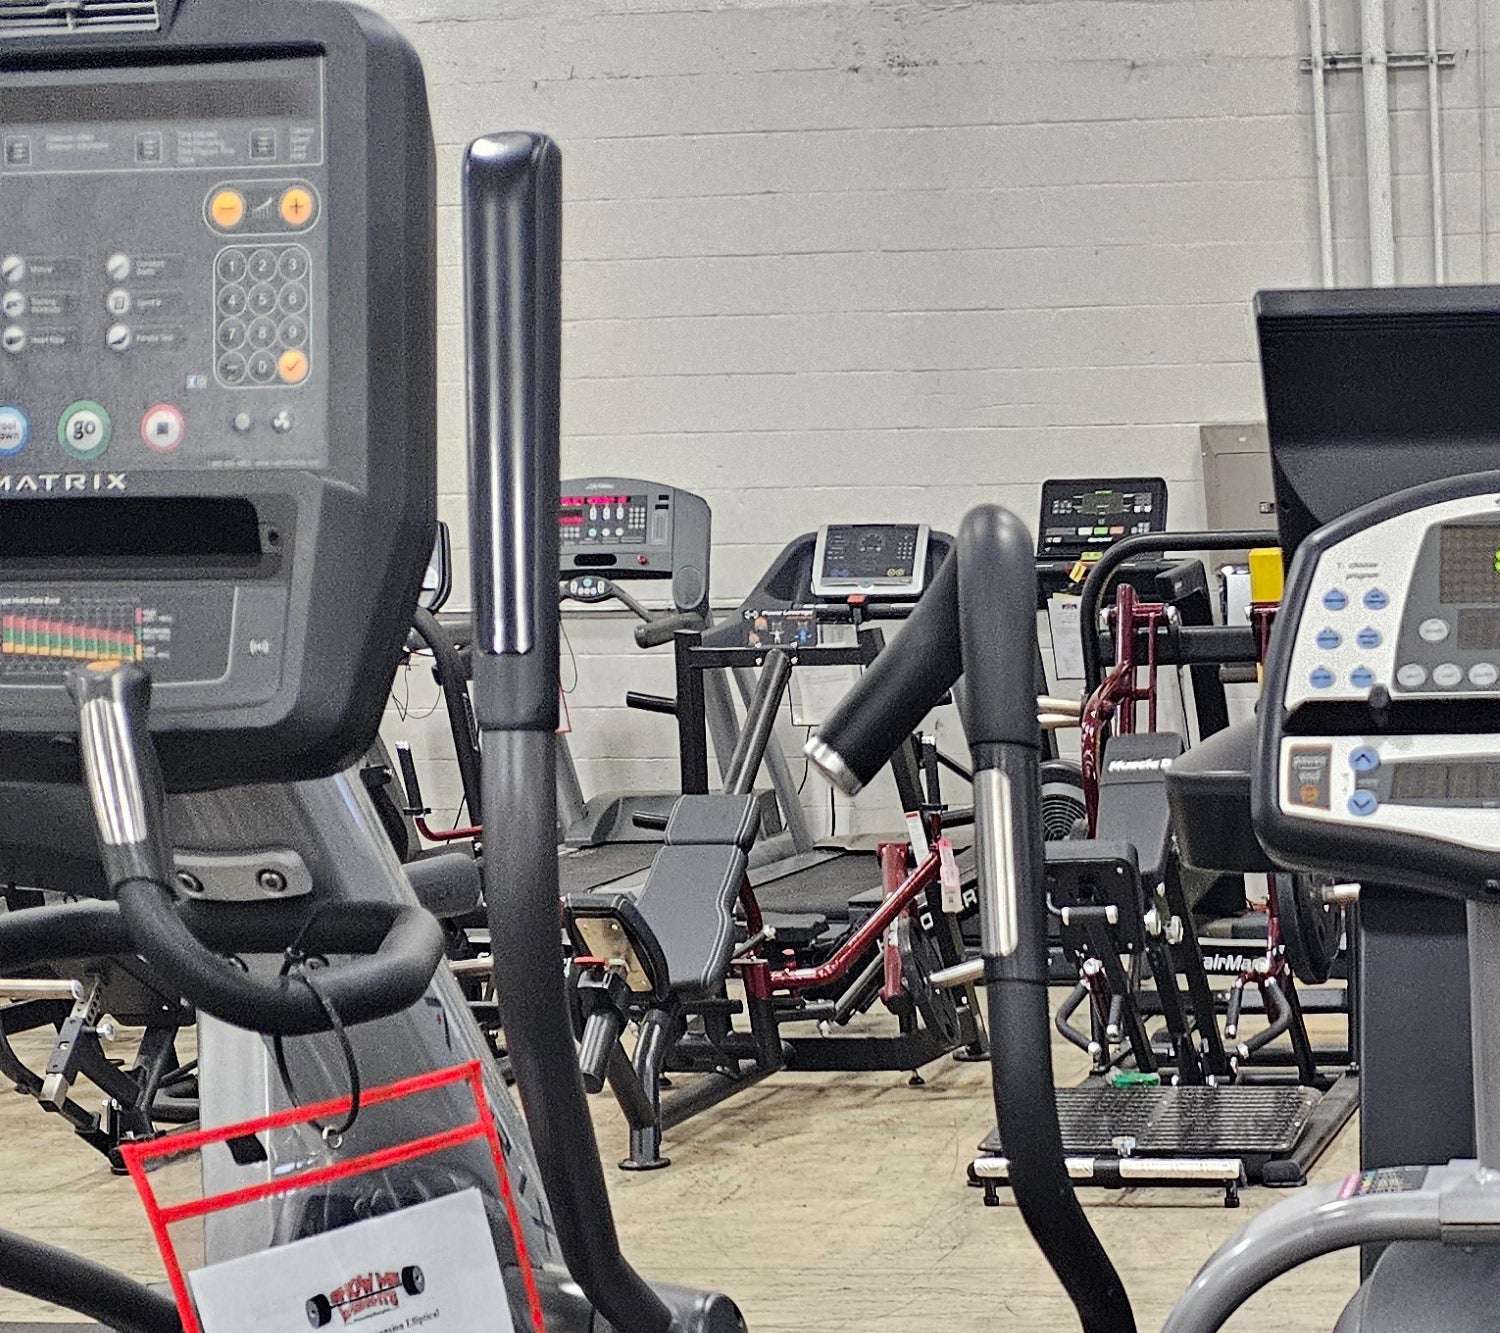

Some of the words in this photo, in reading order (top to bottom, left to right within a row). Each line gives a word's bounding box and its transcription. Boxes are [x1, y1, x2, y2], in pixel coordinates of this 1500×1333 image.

[258, 260, 266, 271] 2
[289, 258, 297, 270] 3
[228, 295, 236, 306] 4
[228, 328, 236, 340] 7
[73, 420, 96, 440] go
